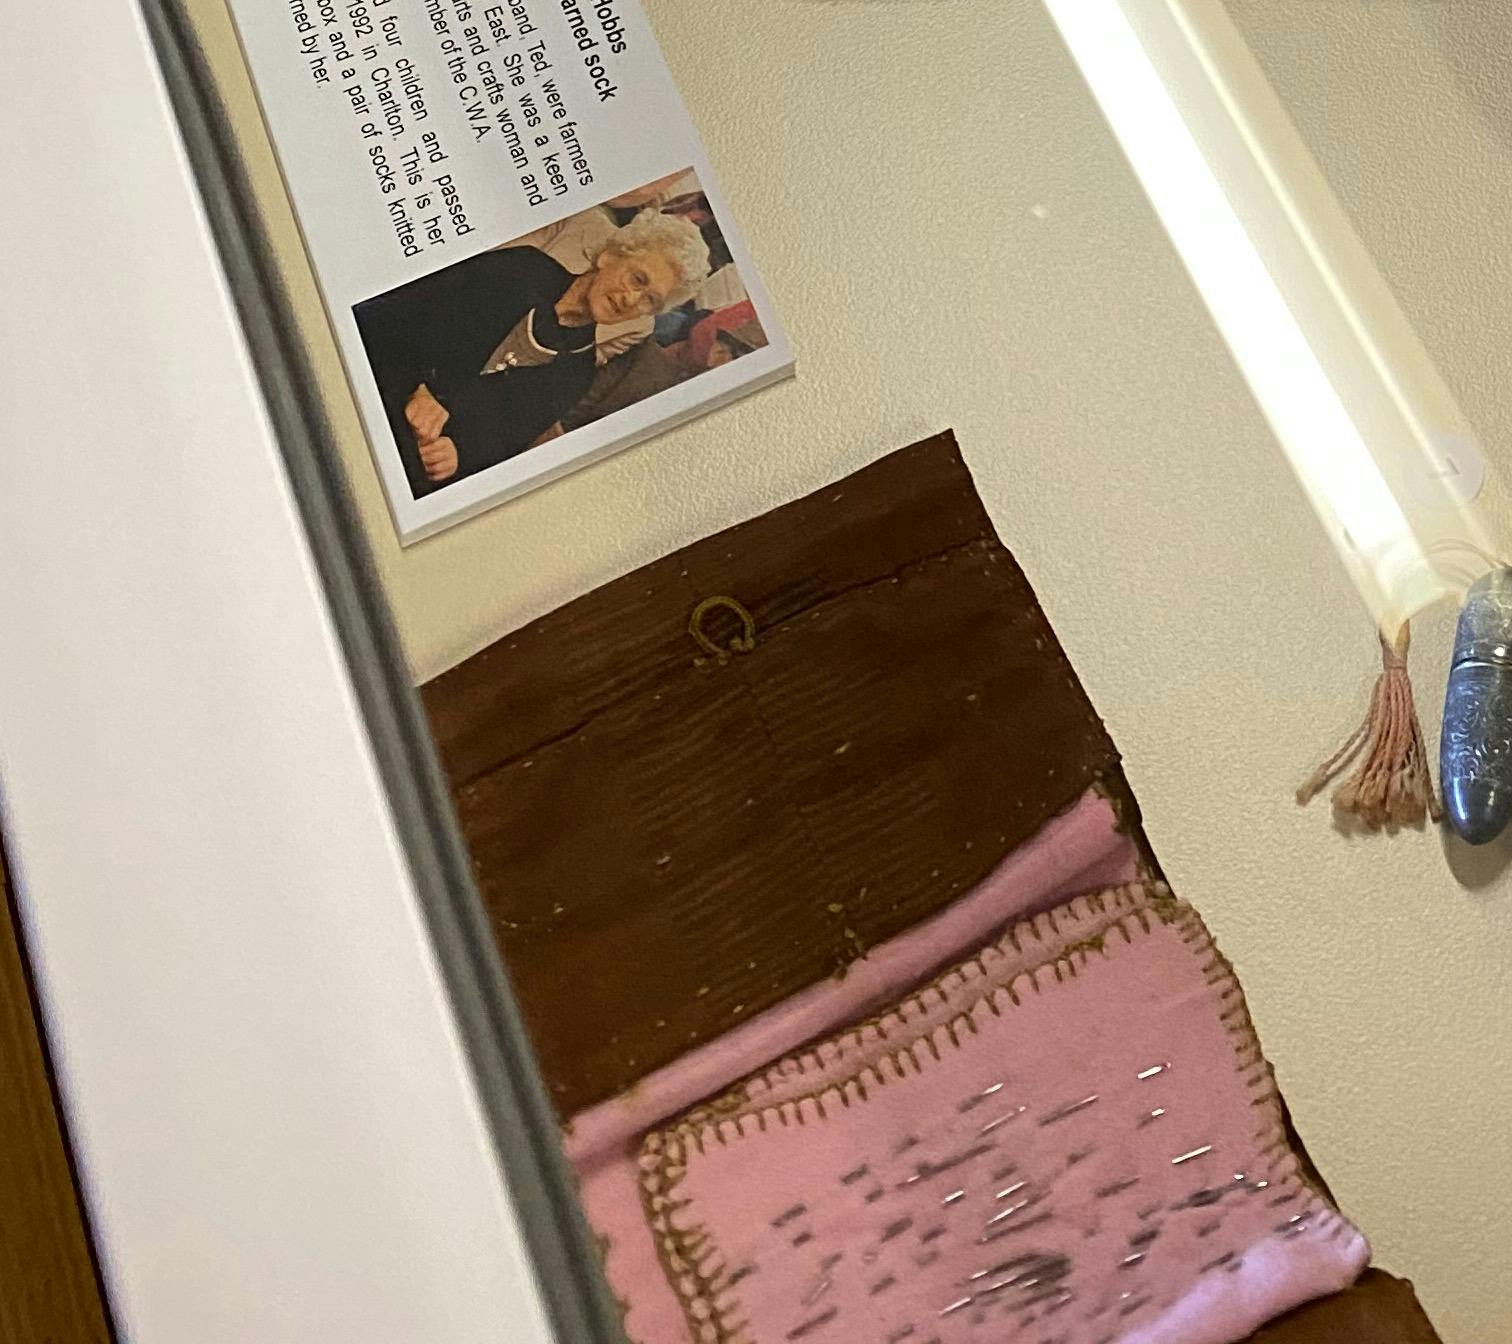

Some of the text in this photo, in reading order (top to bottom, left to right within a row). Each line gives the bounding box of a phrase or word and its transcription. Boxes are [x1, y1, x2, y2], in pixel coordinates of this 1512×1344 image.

[300, 33, 321, 54] by
[379, 15, 403, 47] four
[483, 5, 512, 48] East.
[328, 31, 355, 62] and
[360, 43, 380, 62] in
[440, 39, 463, 55] of
[309, 55, 331, 89] her.
[341, 67, 356, 80] a
[447, 56, 468, 84] the
[503, 53, 526, 87] She
[584, 54, 618, 103] sock
[342, 84, 373, 115] pair
[370, 67, 405, 142] Charlton.
[395, 58, 428, 122] children
[459, 85, 492, 143] C.W.A.
[463, 26, 491, 57] and
[477, 60, 505, 105] crafts
[495, 107, 529, 170] woman
[520, 173, 549, 207] and
[518, 92, 542, 128] was
[527, 39, 553, 78] Ted,
[541, 78, 567, 120] were
[557, 121, 594, 186] farmers
[360, 122, 383, 139] of
[421, 131, 449, 164] and
[534, 135, 550, 148] a
[368, 145, 397, 194] socks
[399, 146, 425, 186] This
[541, 152, 569, 197] keen
[413, 191, 434, 210] is
[431, 174, 476, 237] passed
[387, 197, 424, 258] knitted
[422, 214, 446, 246] her
